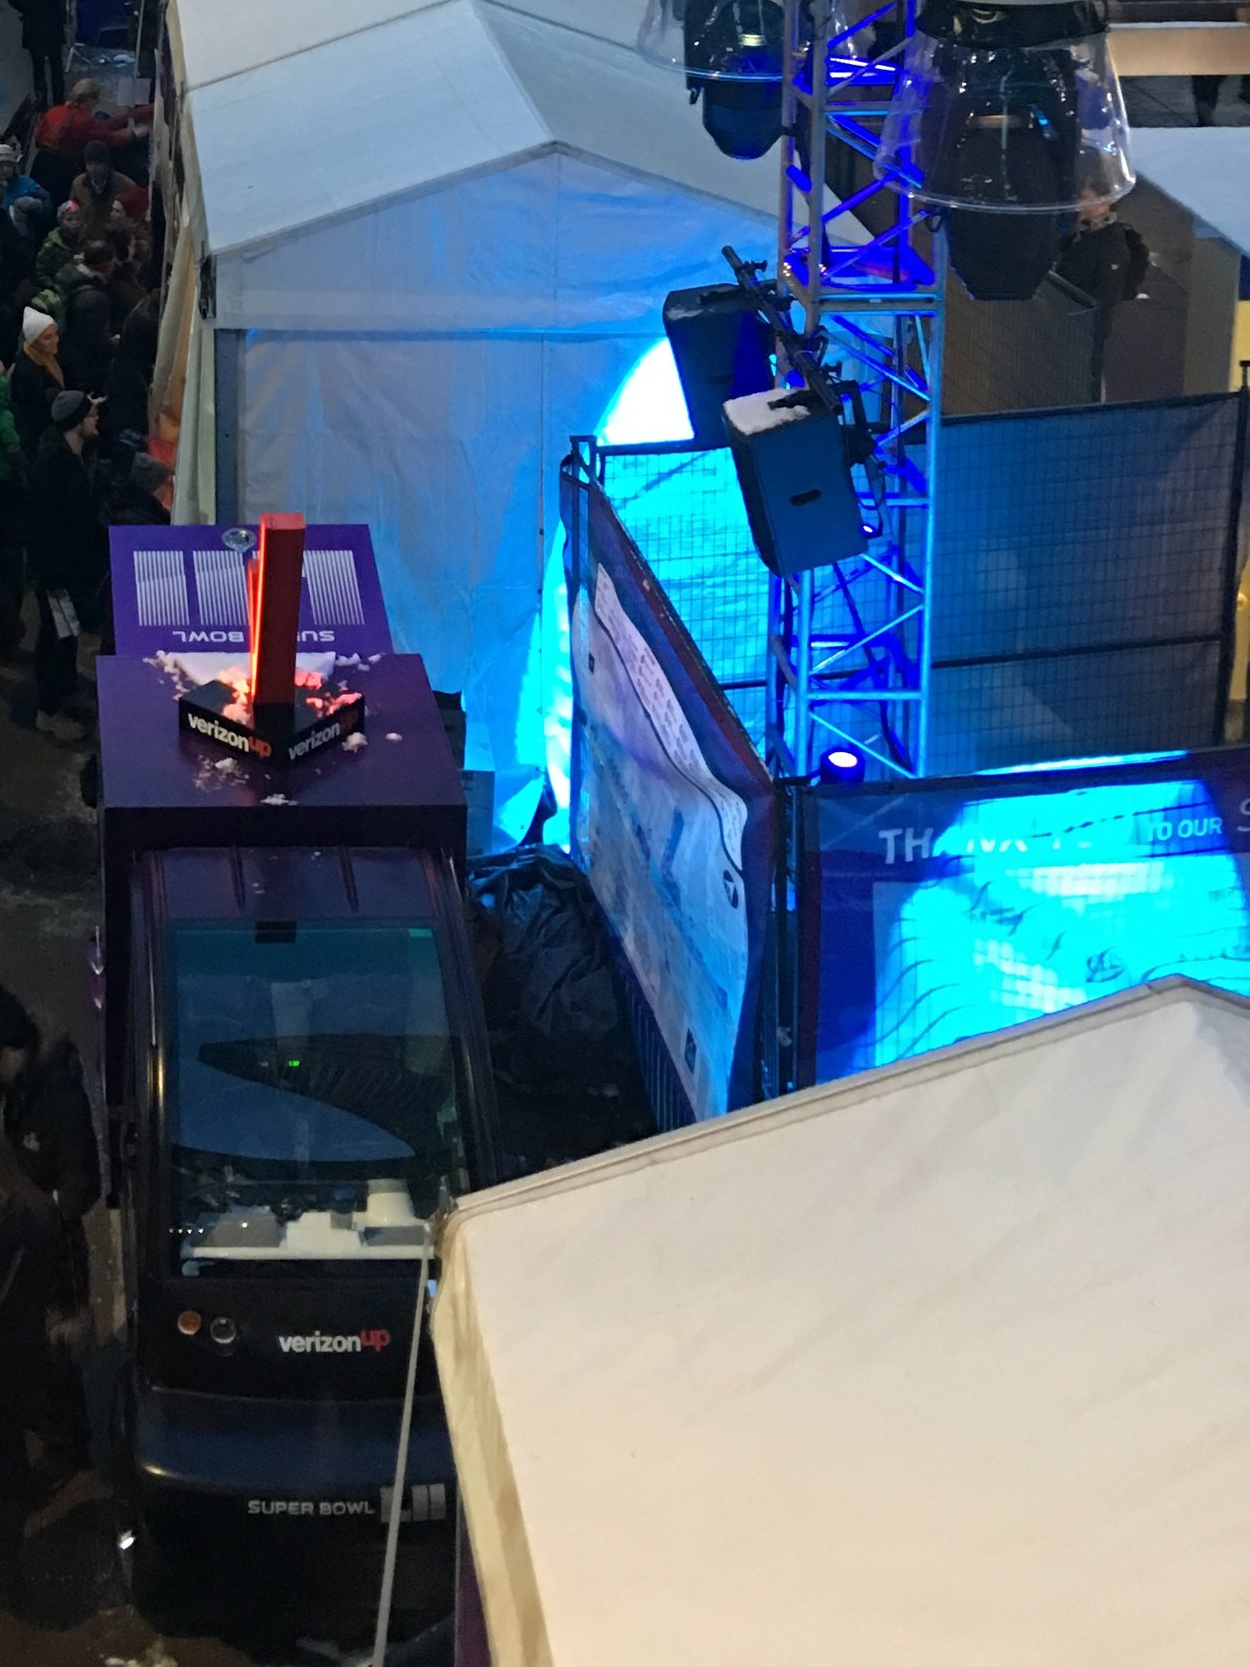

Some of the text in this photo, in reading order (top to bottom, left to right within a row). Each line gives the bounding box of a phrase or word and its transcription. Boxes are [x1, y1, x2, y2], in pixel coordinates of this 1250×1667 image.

[172, 630, 244, 643] BOWL
[187, 712, 272, 759] verizonup
[1177, 817, 1223, 839] OUR
[278, 1329, 391, 1353] verizonup
[247, 1499, 314, 1515] SUPER
[318, 1500, 375, 1515] BOWL
